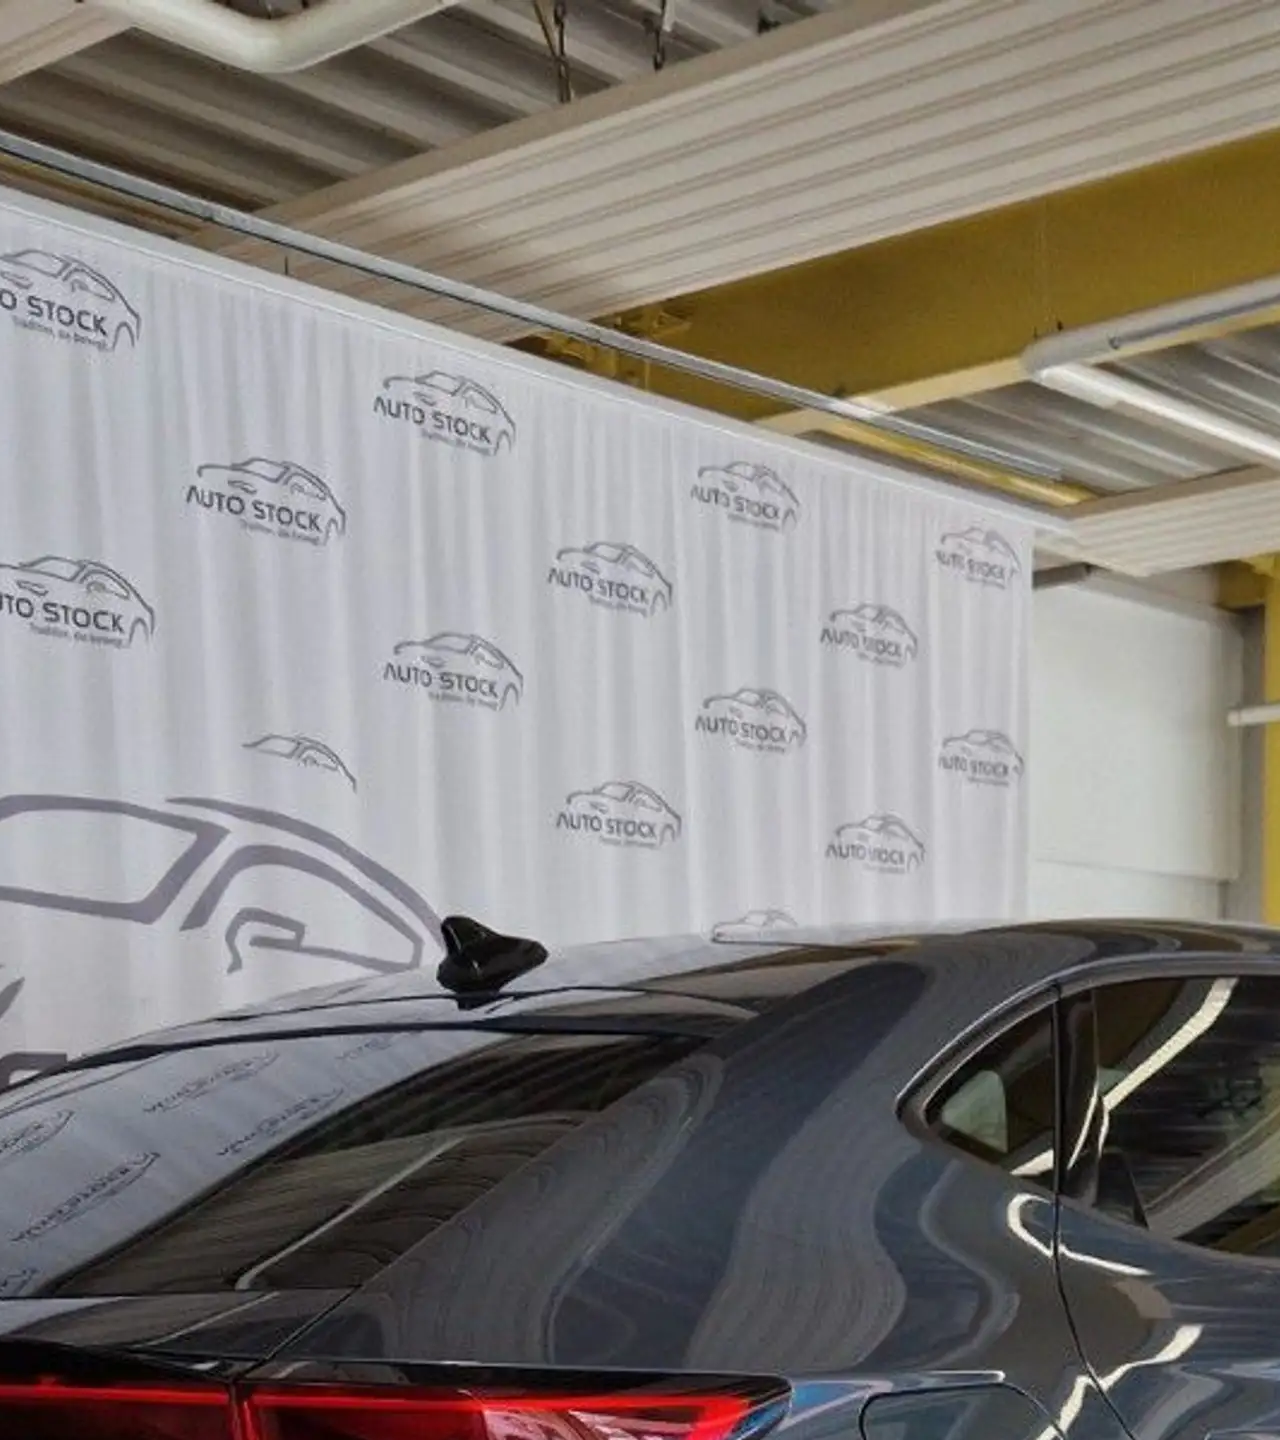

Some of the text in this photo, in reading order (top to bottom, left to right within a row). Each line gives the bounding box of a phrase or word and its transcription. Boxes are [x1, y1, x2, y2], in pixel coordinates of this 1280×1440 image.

[27, 297, 108, 335] STOCK
[374, 396, 424, 425] AUTO
[432, 411, 491, 443] STOCK
[186, 485, 322, 532] AUTO STOCK
[690, 485, 780, 519] AUTO STOCK
[548, 568, 650, 603] AUTO STOCK
[42, 603, 124, 633] STOCK
[384, 663, 499, 698] AUTO STOCK
[695, 716, 786, 740] AUTO STOCK
[939, 756, 968, 771] AUTO
[556, 811, 657, 838] AUTO STOCK
